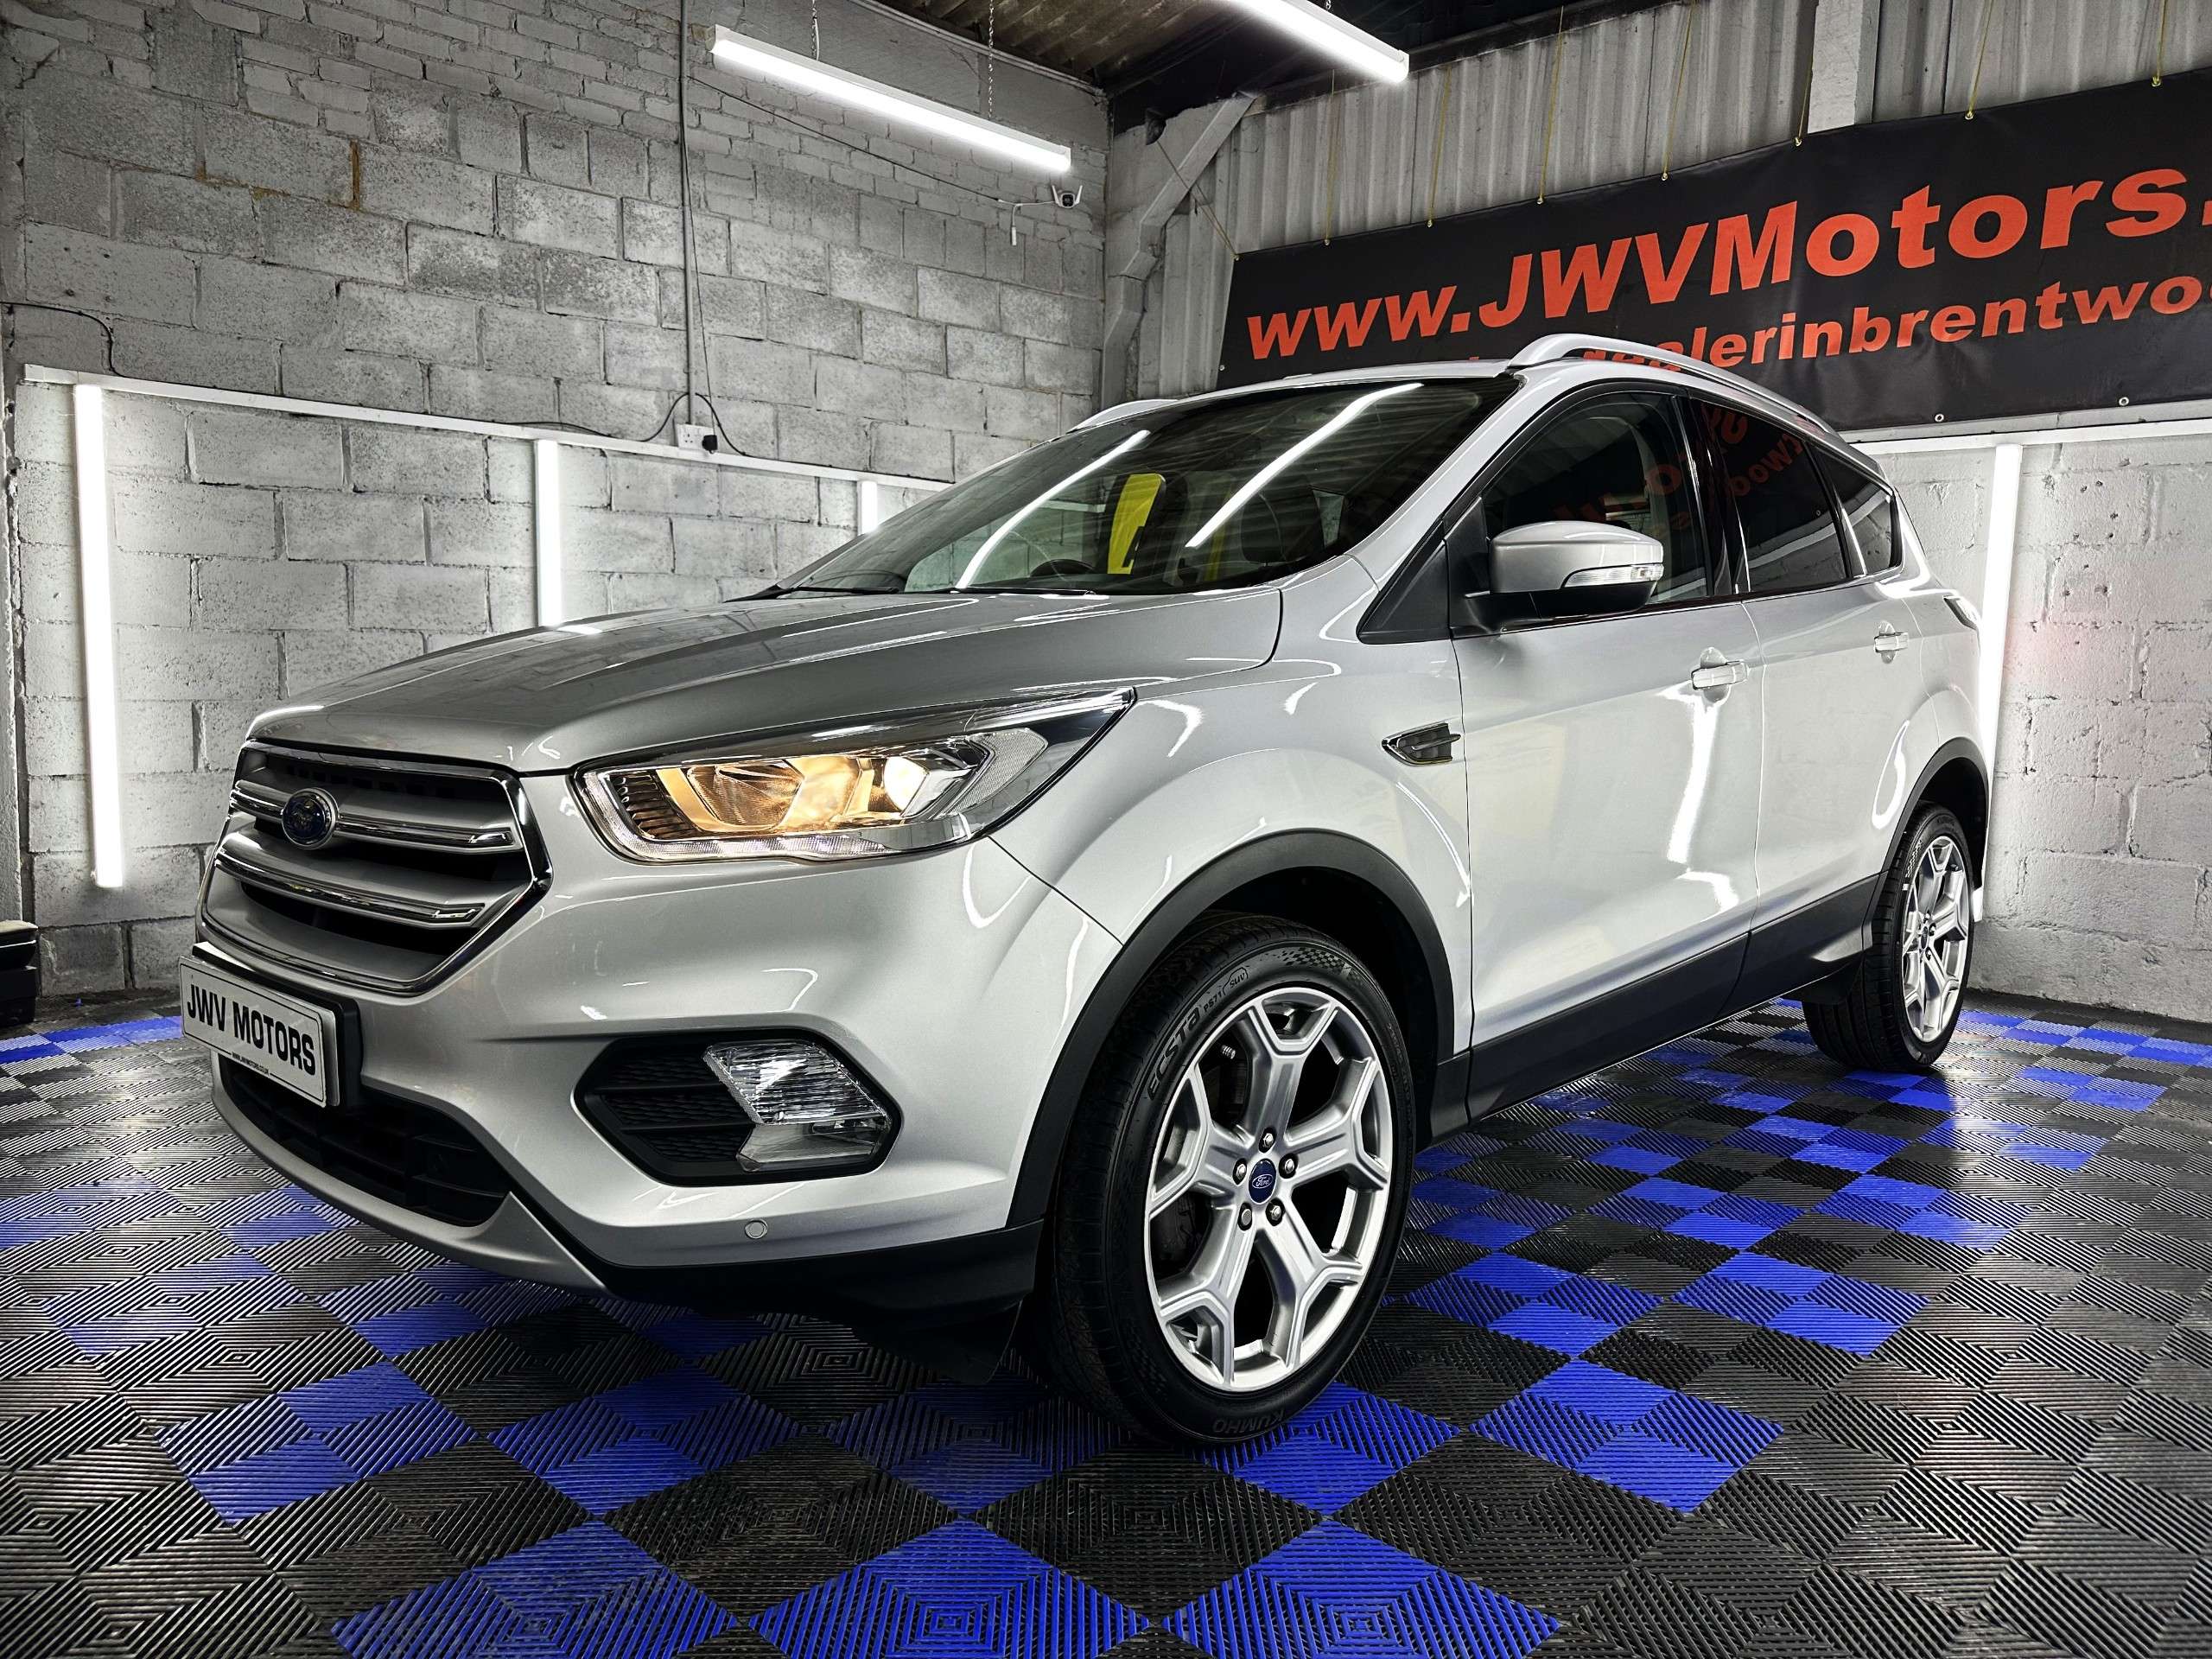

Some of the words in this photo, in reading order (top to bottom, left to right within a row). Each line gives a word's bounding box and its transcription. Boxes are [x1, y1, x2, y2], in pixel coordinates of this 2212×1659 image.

[187, 985, 226, 1032] JWV
[232, 1002, 315, 1076] MOTORS
[1213, 1408, 1284, 1433] KUMHO
